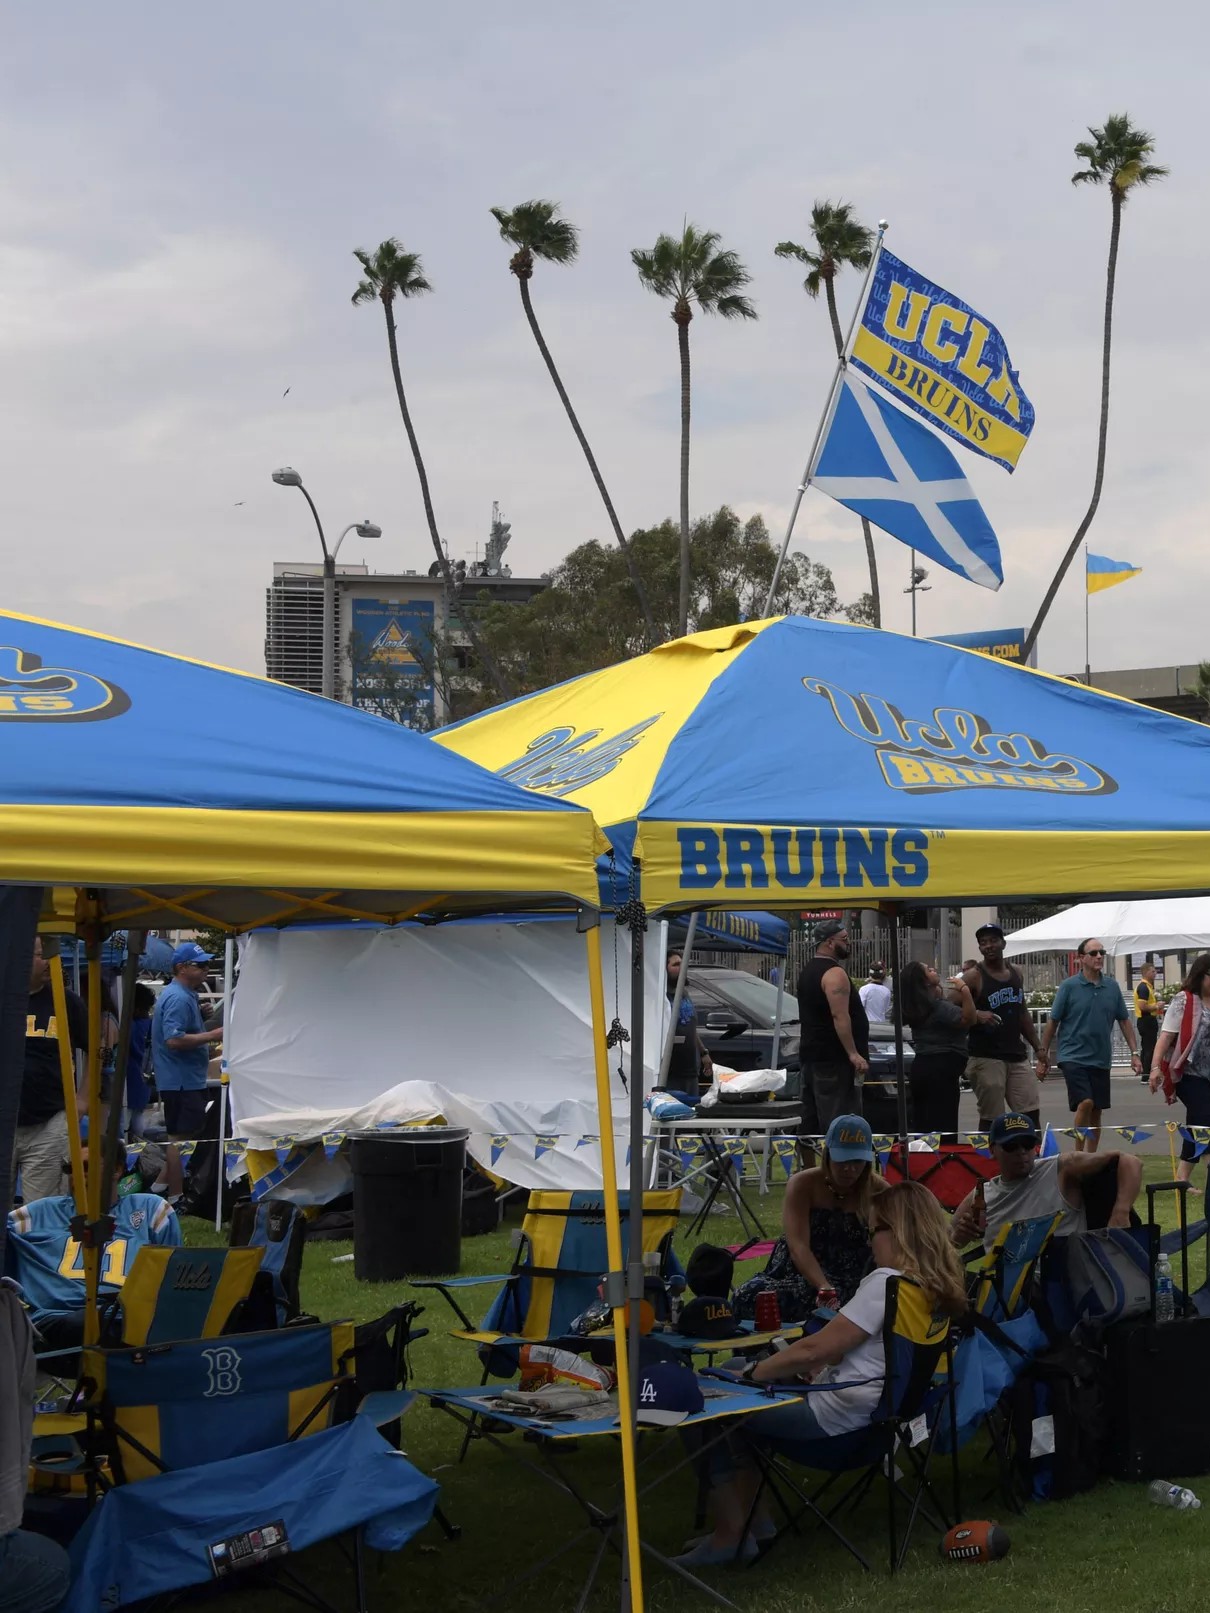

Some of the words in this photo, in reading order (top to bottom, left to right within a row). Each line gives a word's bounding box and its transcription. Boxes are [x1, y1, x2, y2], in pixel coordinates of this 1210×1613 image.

[883, 280, 1021, 423] UCLA
[885, 352, 992, 442] BRUINS
[802, 676, 1105, 786] Ucla
[889, 755, 1088, 790] BRUINS
[677, 827, 929, 890] BRUINS
[839, 1128, 866, 1144] Ucla
[1003, 1115, 1030, 1131] Ucla
[704, 1303, 733, 1321] Ucla
[201, 1346, 243, 1398] B
[640, 1378, 657, 1402] LA
